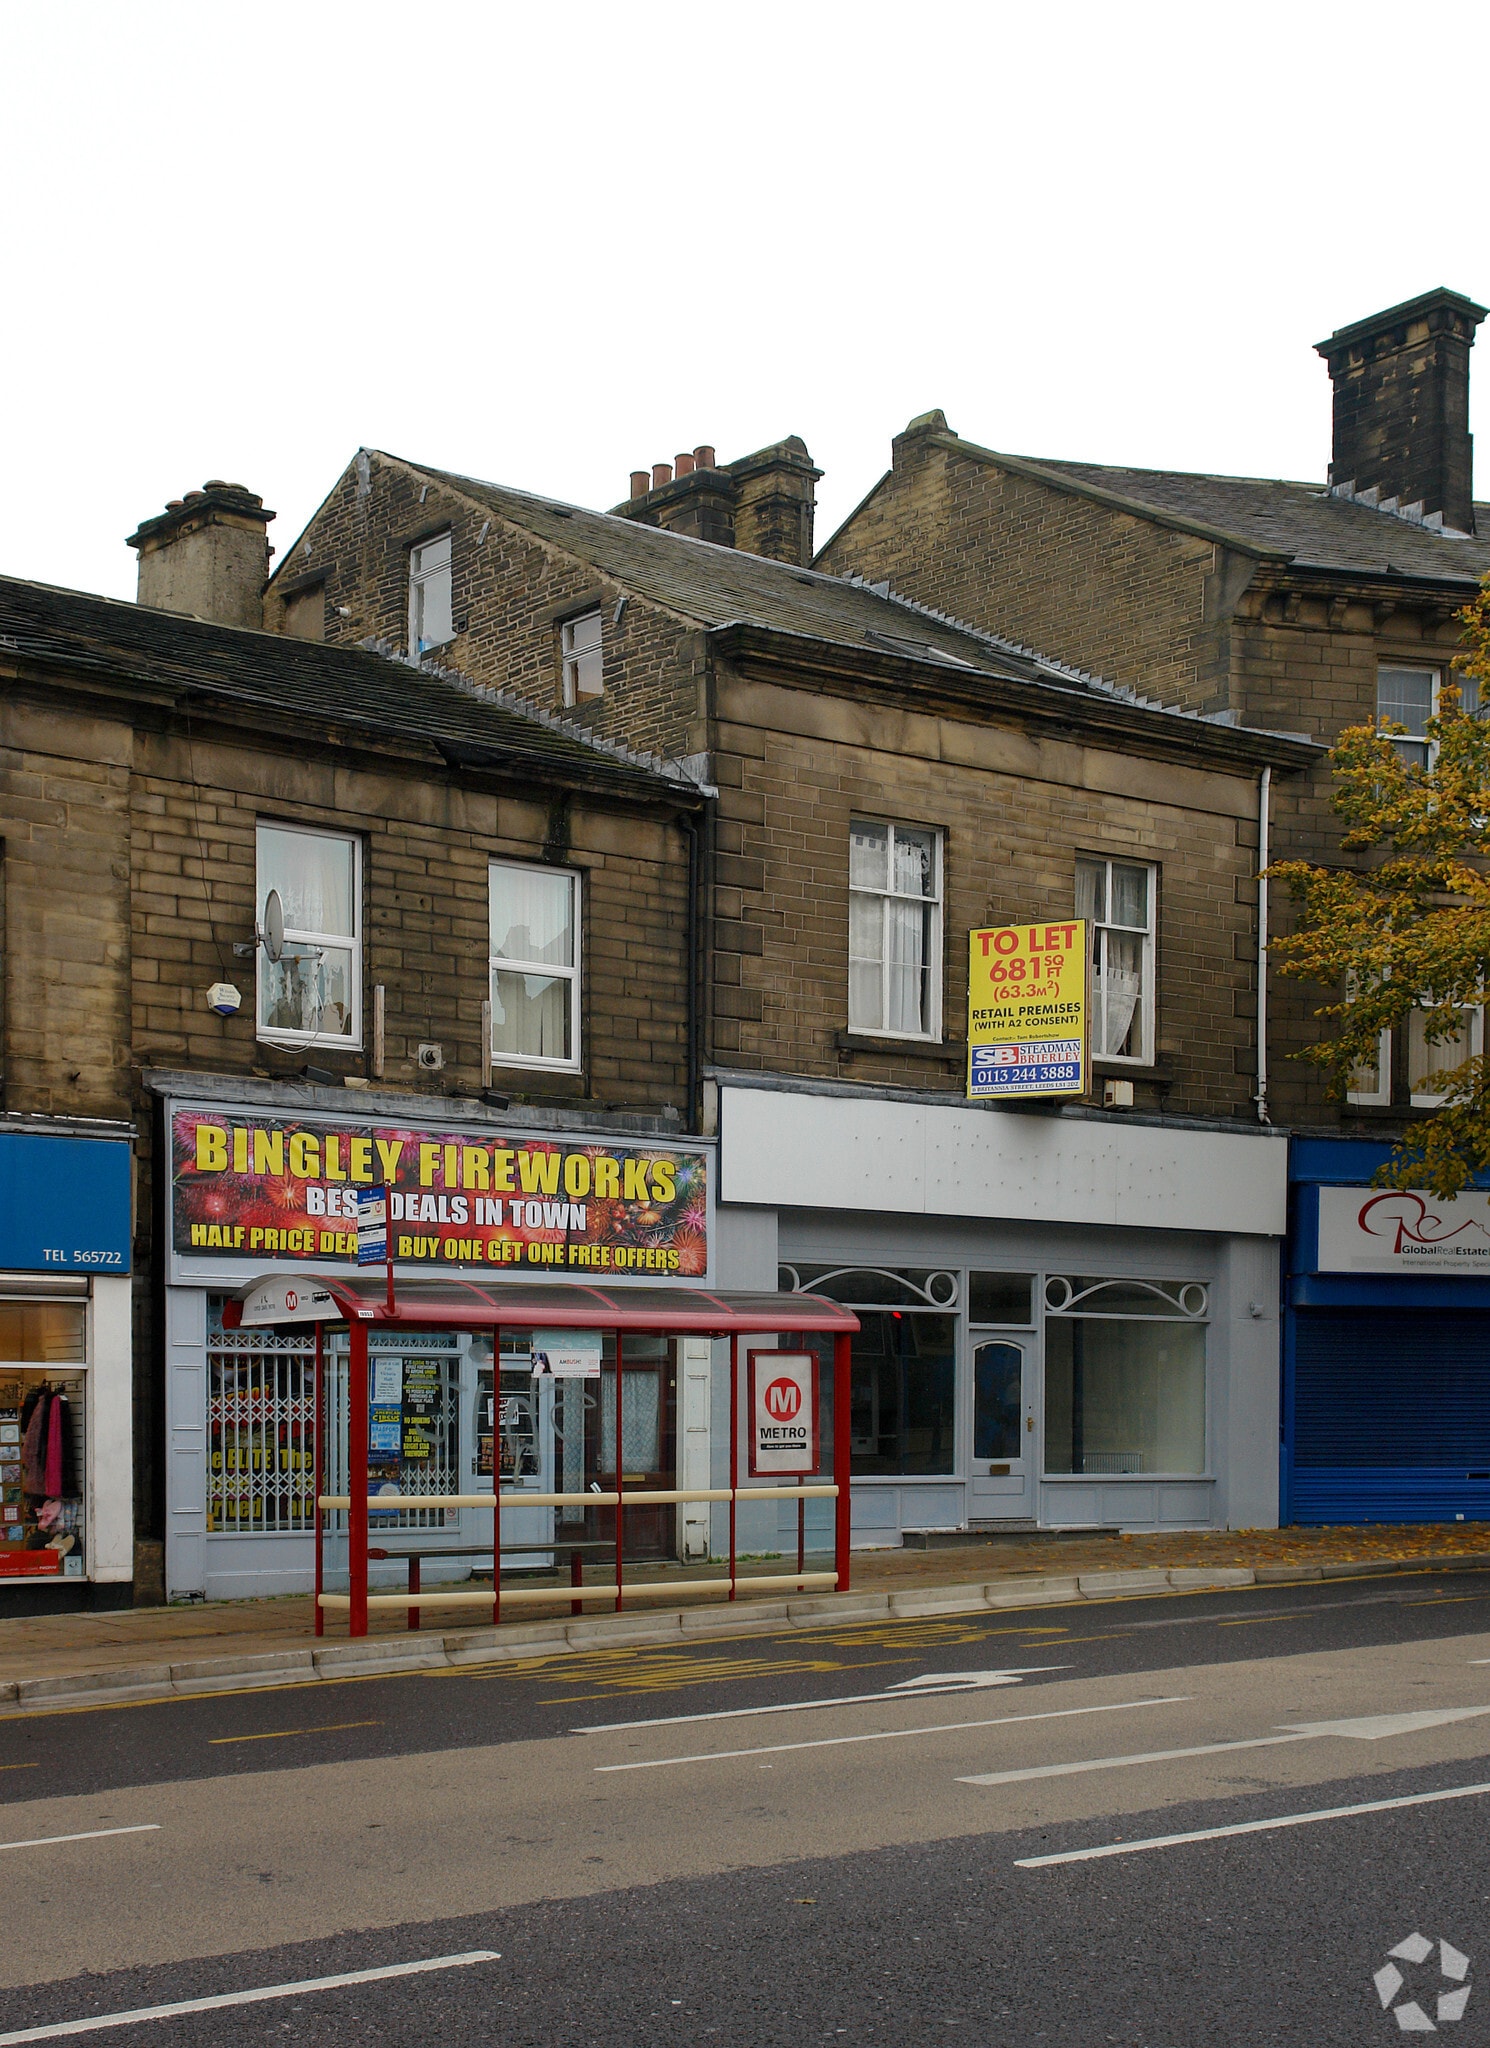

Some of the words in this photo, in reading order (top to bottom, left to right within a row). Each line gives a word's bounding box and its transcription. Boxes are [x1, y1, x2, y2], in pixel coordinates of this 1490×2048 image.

[977, 930, 1019, 957] TO
[1029, 924, 1078, 953] LET
[1044, 954, 1064, 966] SQ
[989, 956, 1040, 982] 681
[1046, 966, 1062, 978] FT
[972, 1008, 1014, 1020] RETAIL
[1019, 1002, 1080, 1016] PREMISES
[974, 1020, 1004, 1032] (WITH
[1008, 1020, 1022, 1028] A2
[1025, 1016, 1078, 1026] CONSENT)
[1020, 1042, 1080, 1054] STEADMAN
[975, 1048, 1016, 1066] SB
[1020, 1052, 1080, 1064] BRIERLEY
[978, 1069, 1008, 1083] 0113
[1012, 1067, 1036, 1082] 244
[1040, 1066, 1074, 1080] 3888
[196, 1124, 404, 1184] BINGLEY
[419, 1143, 678, 1203] FIREWORKS
[306, 1187, 358, 1219] BES
[391, 1192, 468, 1224] DEALS
[475, 1198, 502, 1226] IN
[509, 1200, 586, 1231] TOWN
[190, 1224, 246, 1249] HALF
[250, 1227, 314, 1252] PRICE
[320, 1231, 358, 1255] DEA
[398, 1236, 440, 1258] BUY
[445, 1238, 484, 1260] ONE
[488, 1240, 524, 1262] GET
[528, 1242, 565, 1264] ONE
[569, 1244, 610, 1267] FREE
[614, 1247, 680, 1270] OFFERS
[44, 1249, 67, 1262] TEL
[73, 1250, 122, 1264] 565722
[286, 1294, 296, 1308] M
[770, 1386, 796, 1413] M
[760, 1427, 806, 1439] METRO
[280, 1448, 312, 1469] The
